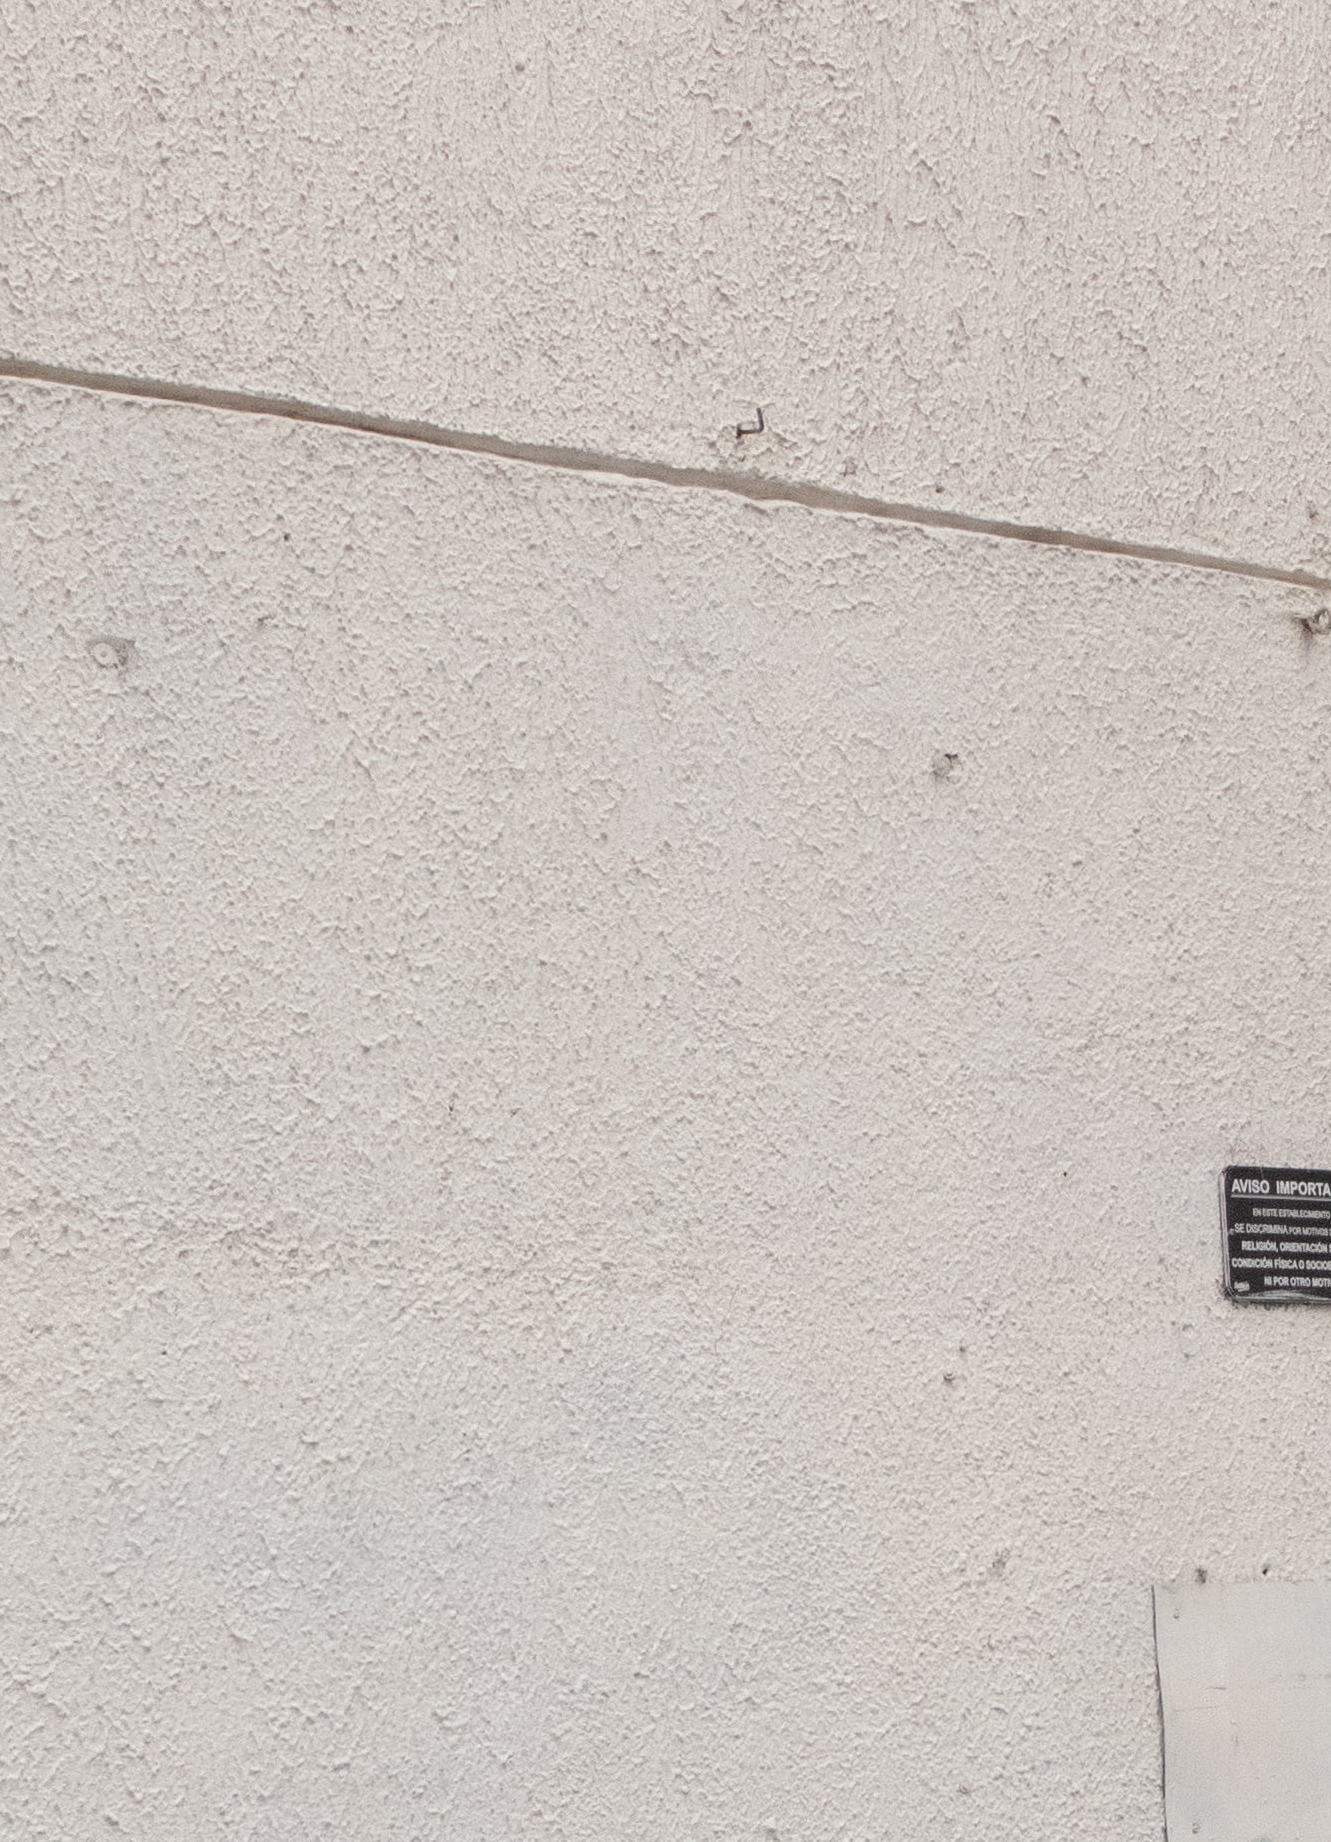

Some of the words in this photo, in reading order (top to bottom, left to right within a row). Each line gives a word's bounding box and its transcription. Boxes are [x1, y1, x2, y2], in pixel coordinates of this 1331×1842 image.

[1231, 1179, 1270, 1194] AVISO
[1234, 1223, 1246, 1234] SE
[1246, 1223, 1288, 1235] DISCRIMINA
[1279, 1240, 1328, 1254] ORIENTACIÓN
[1231, 1257, 1273, 1269] CONDICIÓN
[1274, 1257, 1298, 1270] FÍSICA
[1298, 1260, 1305, 1269] O
[1273, 1276, 1289, 1286] POR
[1290, 1276, 1311, 1287] OTRO
